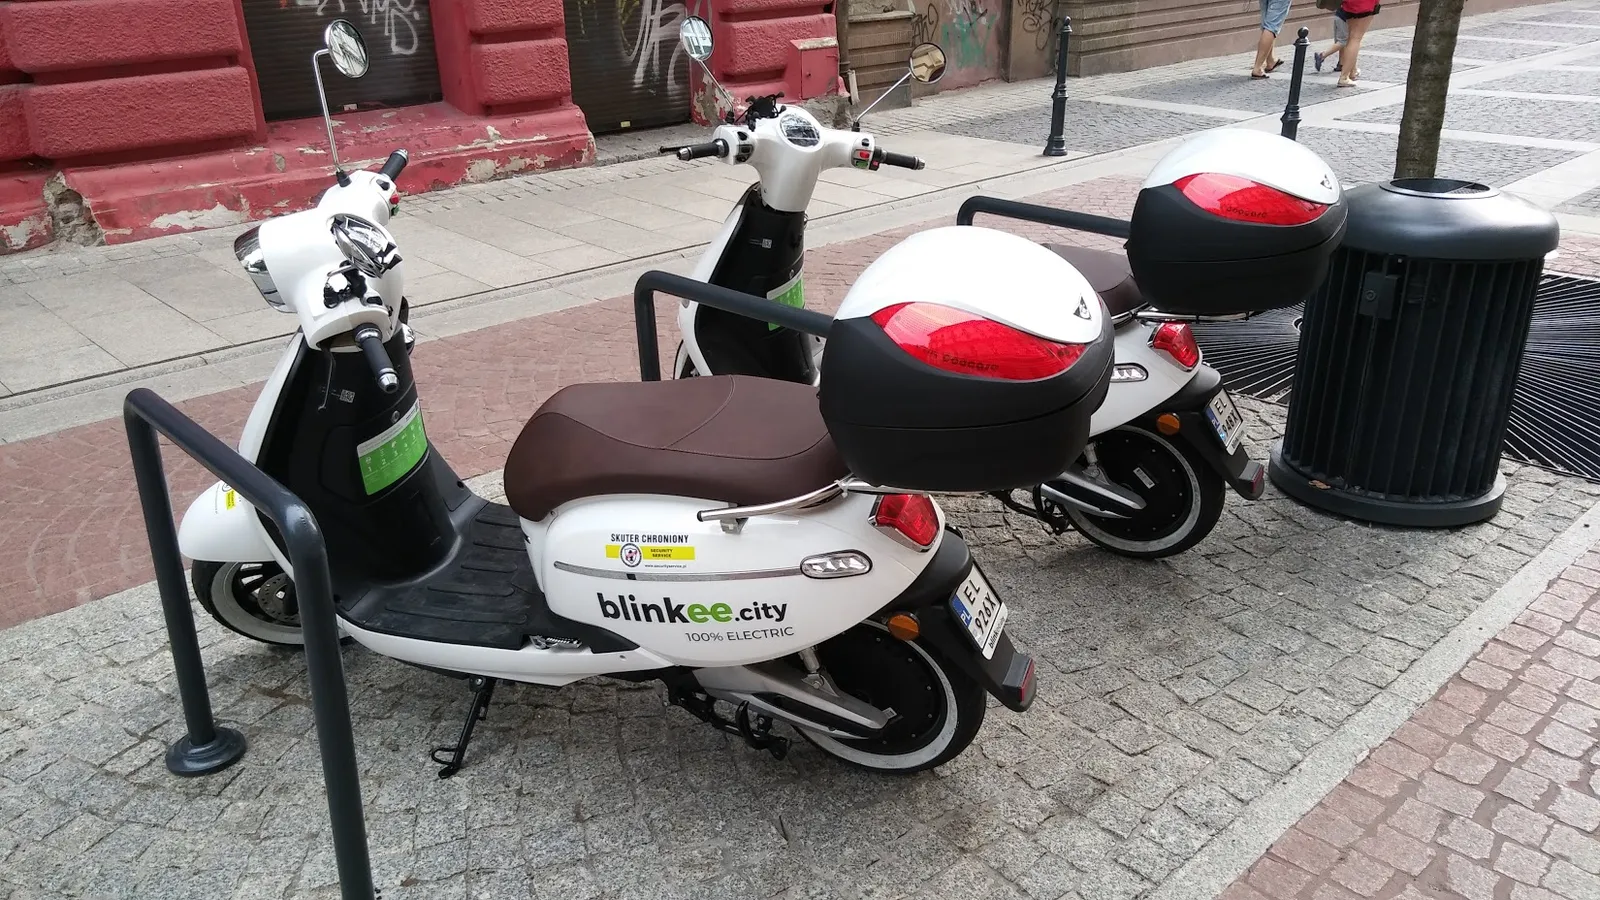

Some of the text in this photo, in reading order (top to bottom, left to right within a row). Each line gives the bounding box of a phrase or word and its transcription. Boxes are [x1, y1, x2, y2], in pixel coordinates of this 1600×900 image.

[1214, 398, 1227, 415] EL
[610, 533, 689, 543] SKUTER CHRONIONY
[963, 579, 981, 605] EL
[596, 592, 788, 623] blinkee.city
[974, 591, 997, 635] 926X
[959, 610, 972, 626] PL
[685, 626, 795, 642] 100% ELECTRIC
